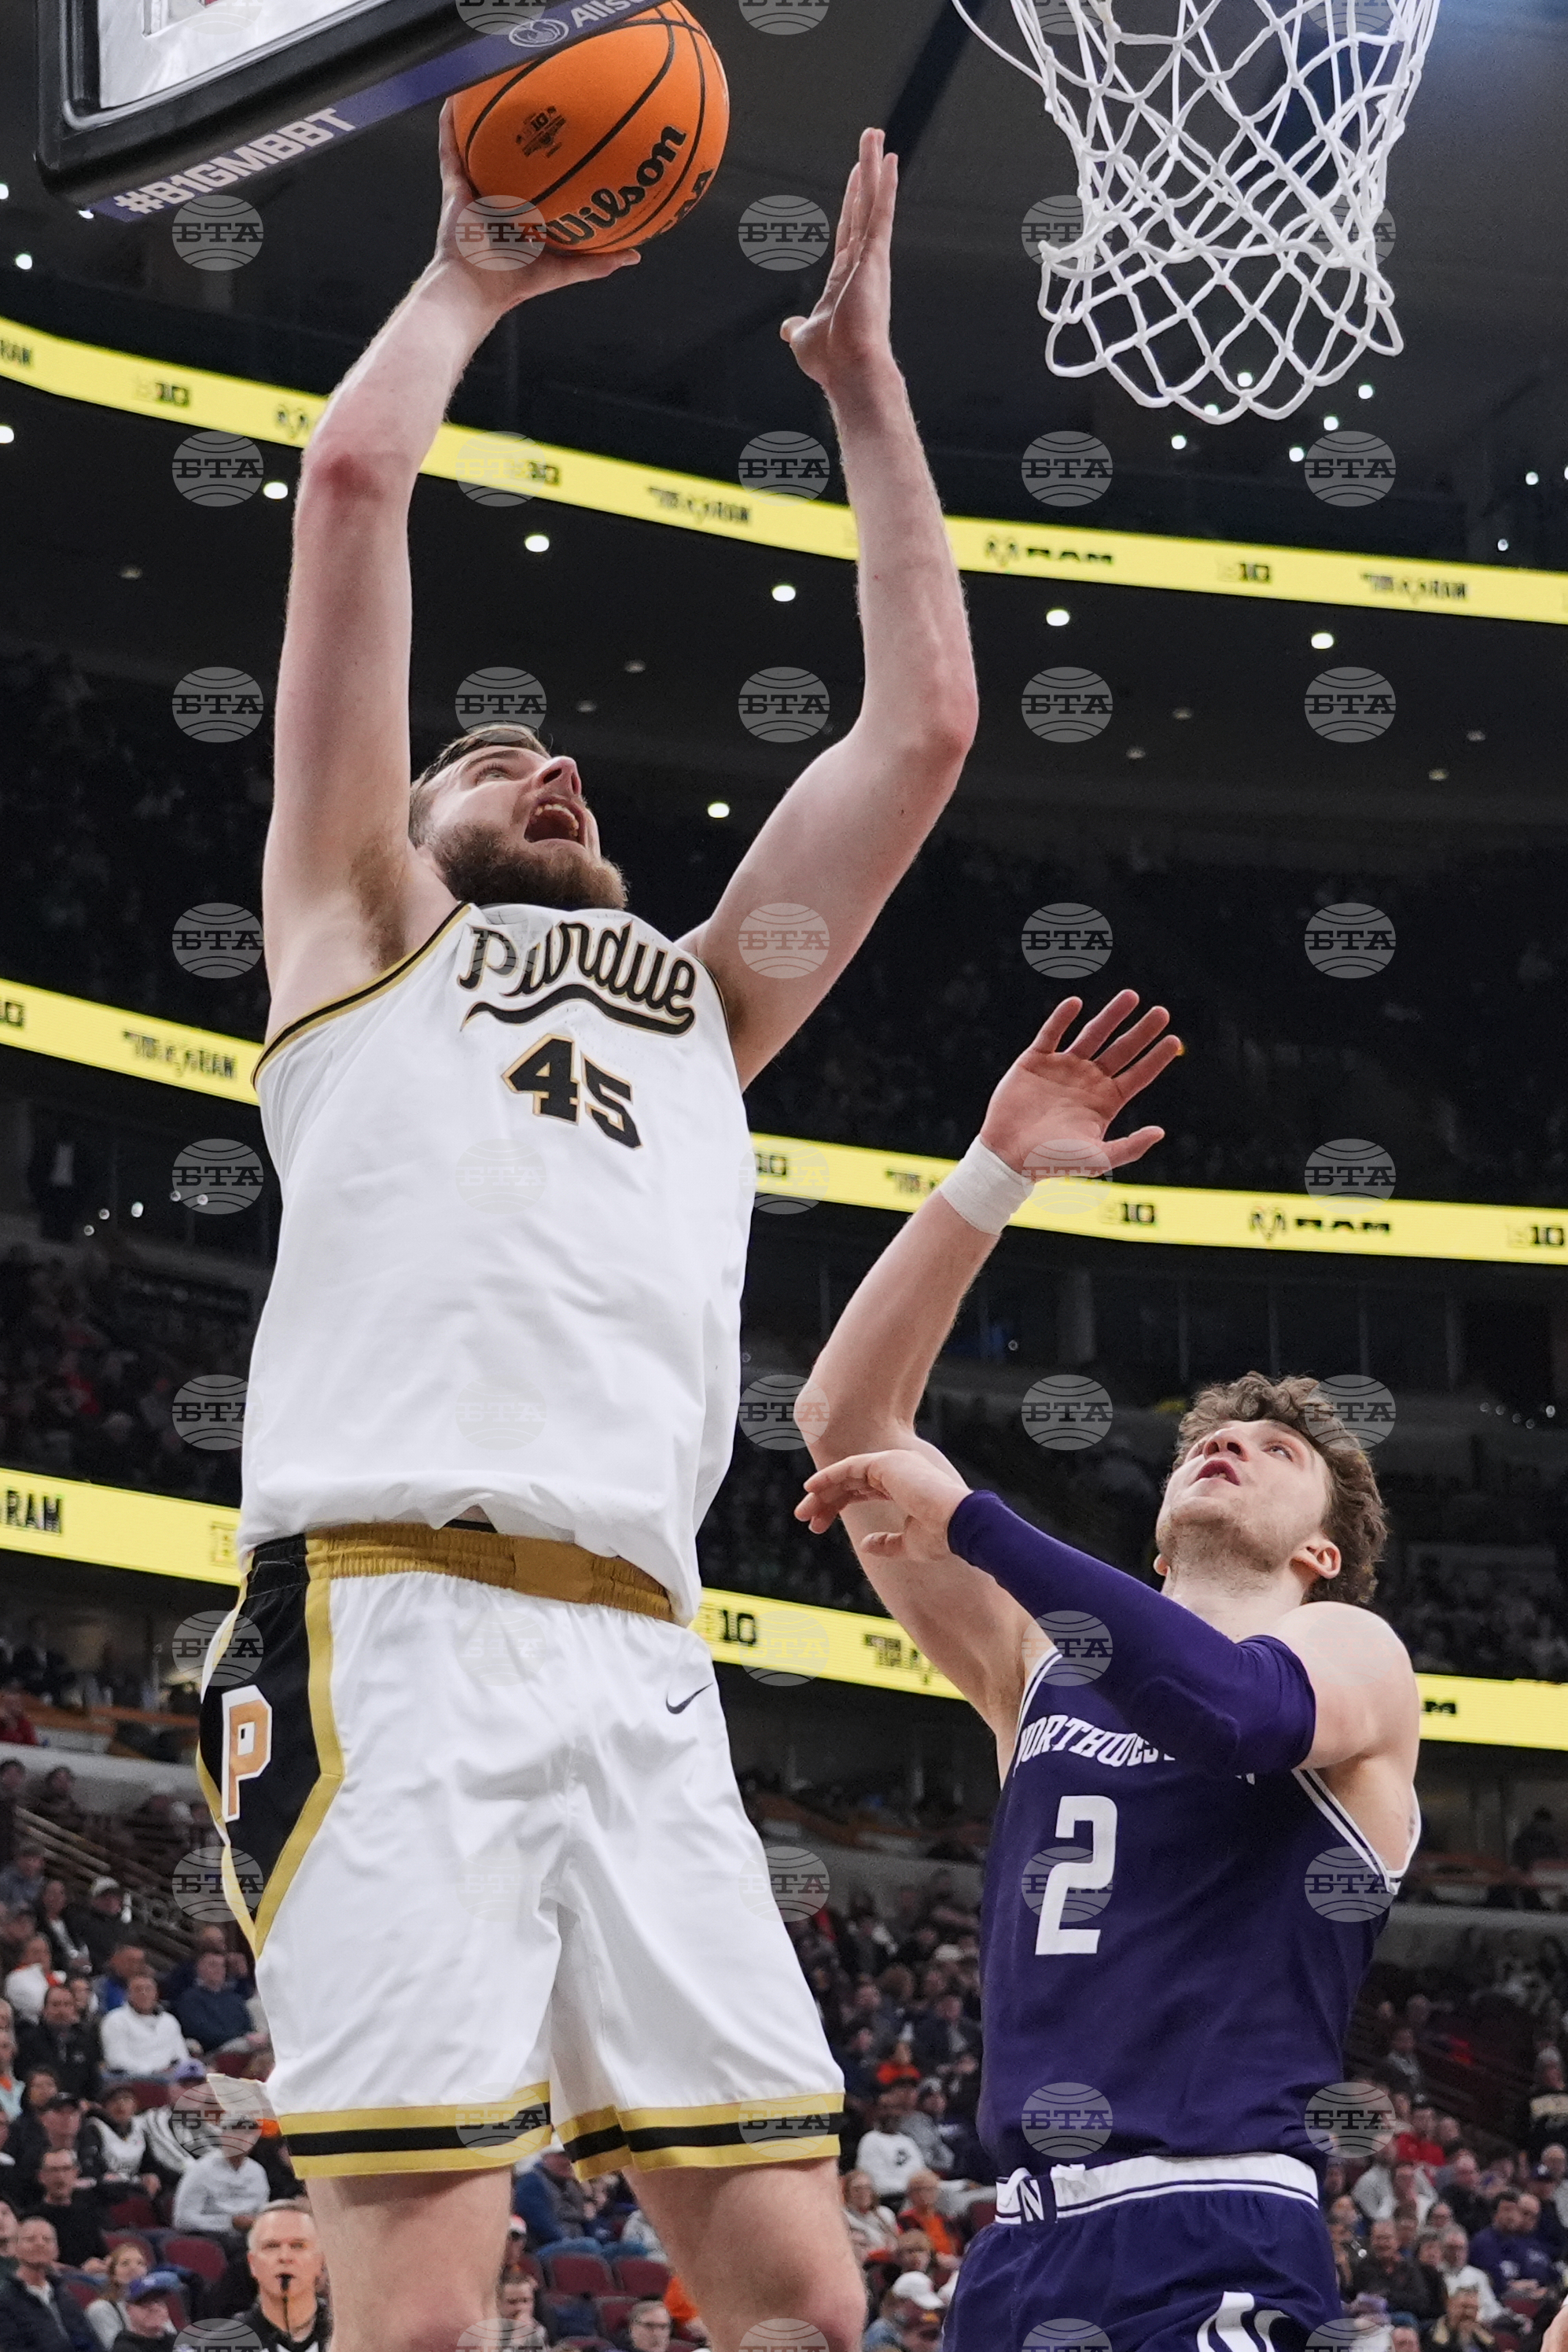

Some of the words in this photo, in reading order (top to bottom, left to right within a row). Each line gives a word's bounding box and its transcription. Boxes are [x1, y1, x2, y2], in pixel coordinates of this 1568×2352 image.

[113, 108, 355, 214] #B1GMBBT
[532, 124, 687, 245] Wilson
[457, 918, 698, 1019] Purdue
[501, 1032, 643, 1151] 45
[1035, 1794, 1117, 1956] 2
